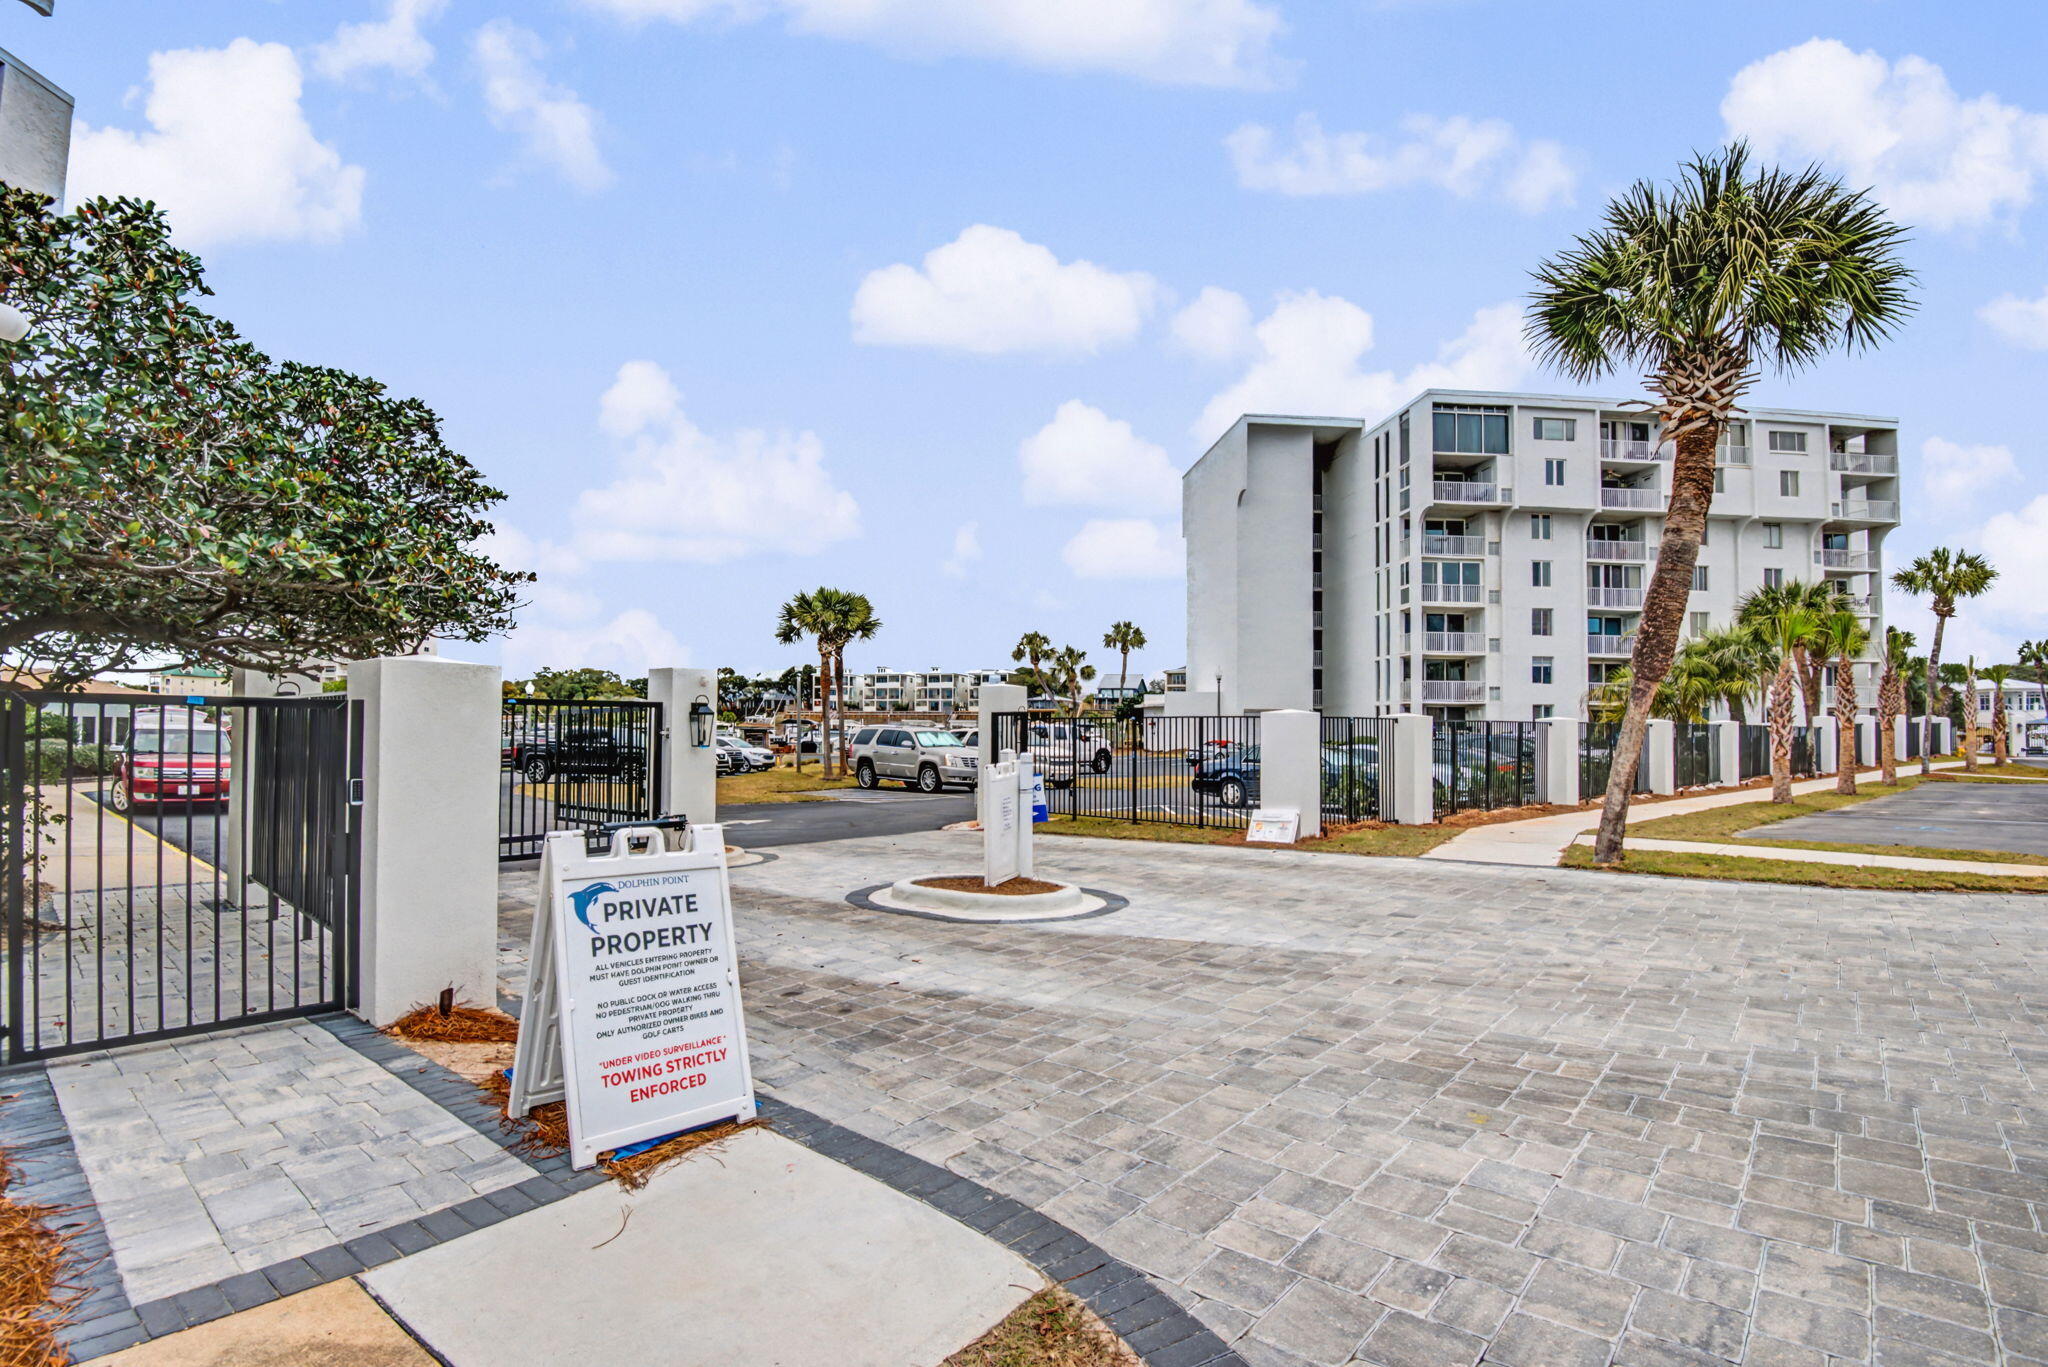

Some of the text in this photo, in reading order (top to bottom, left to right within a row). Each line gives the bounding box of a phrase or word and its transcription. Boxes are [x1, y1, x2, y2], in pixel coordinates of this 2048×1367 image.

[618, 875, 689, 889] DOLPHIN POINT
[604, 894, 698, 922] PRIVATE
[591, 922, 712, 957] PROPERTY
[645, 954, 678, 964] ENTERING
[680, 948, 712, 958] PROPERTY
[589, 973, 609, 981] MUST
[611, 970, 630, 978] HAVE
[631, 965, 661, 975] DOLPHIN
[663, 962, 682, 970] POINT
[684, 958, 708, 967] OWNER
[619, 969, 695, 987] GUEST IDENTIFICATION
[610, 997, 635, 1007] PUBLIC
[637, 994, 656, 1002] DOCK
[669, 987, 692, 996] WATER
[693, 983, 717, 991] ACCESS
[672, 996, 702, 1006] WALKING
[597, 1030, 615, 1039] ONLY
[617, 1020, 661, 1035] AUTHORIZED
[663, 1016, 688, 1025] OWNER
[709, 1008, 724, 1016] AND
[629, 1005, 693, 1023] PRIVATE PROPERTY
[643, 1025, 684, 1039] GOLF CARTS
[635, 1050, 661, 1062] VIDEO
[663, 1036, 722, 1055] SURVEILLANCE
[601, 1048, 727, 1088] TOWING STRICTLY
[630, 1073, 707, 1103] ENFORCED
